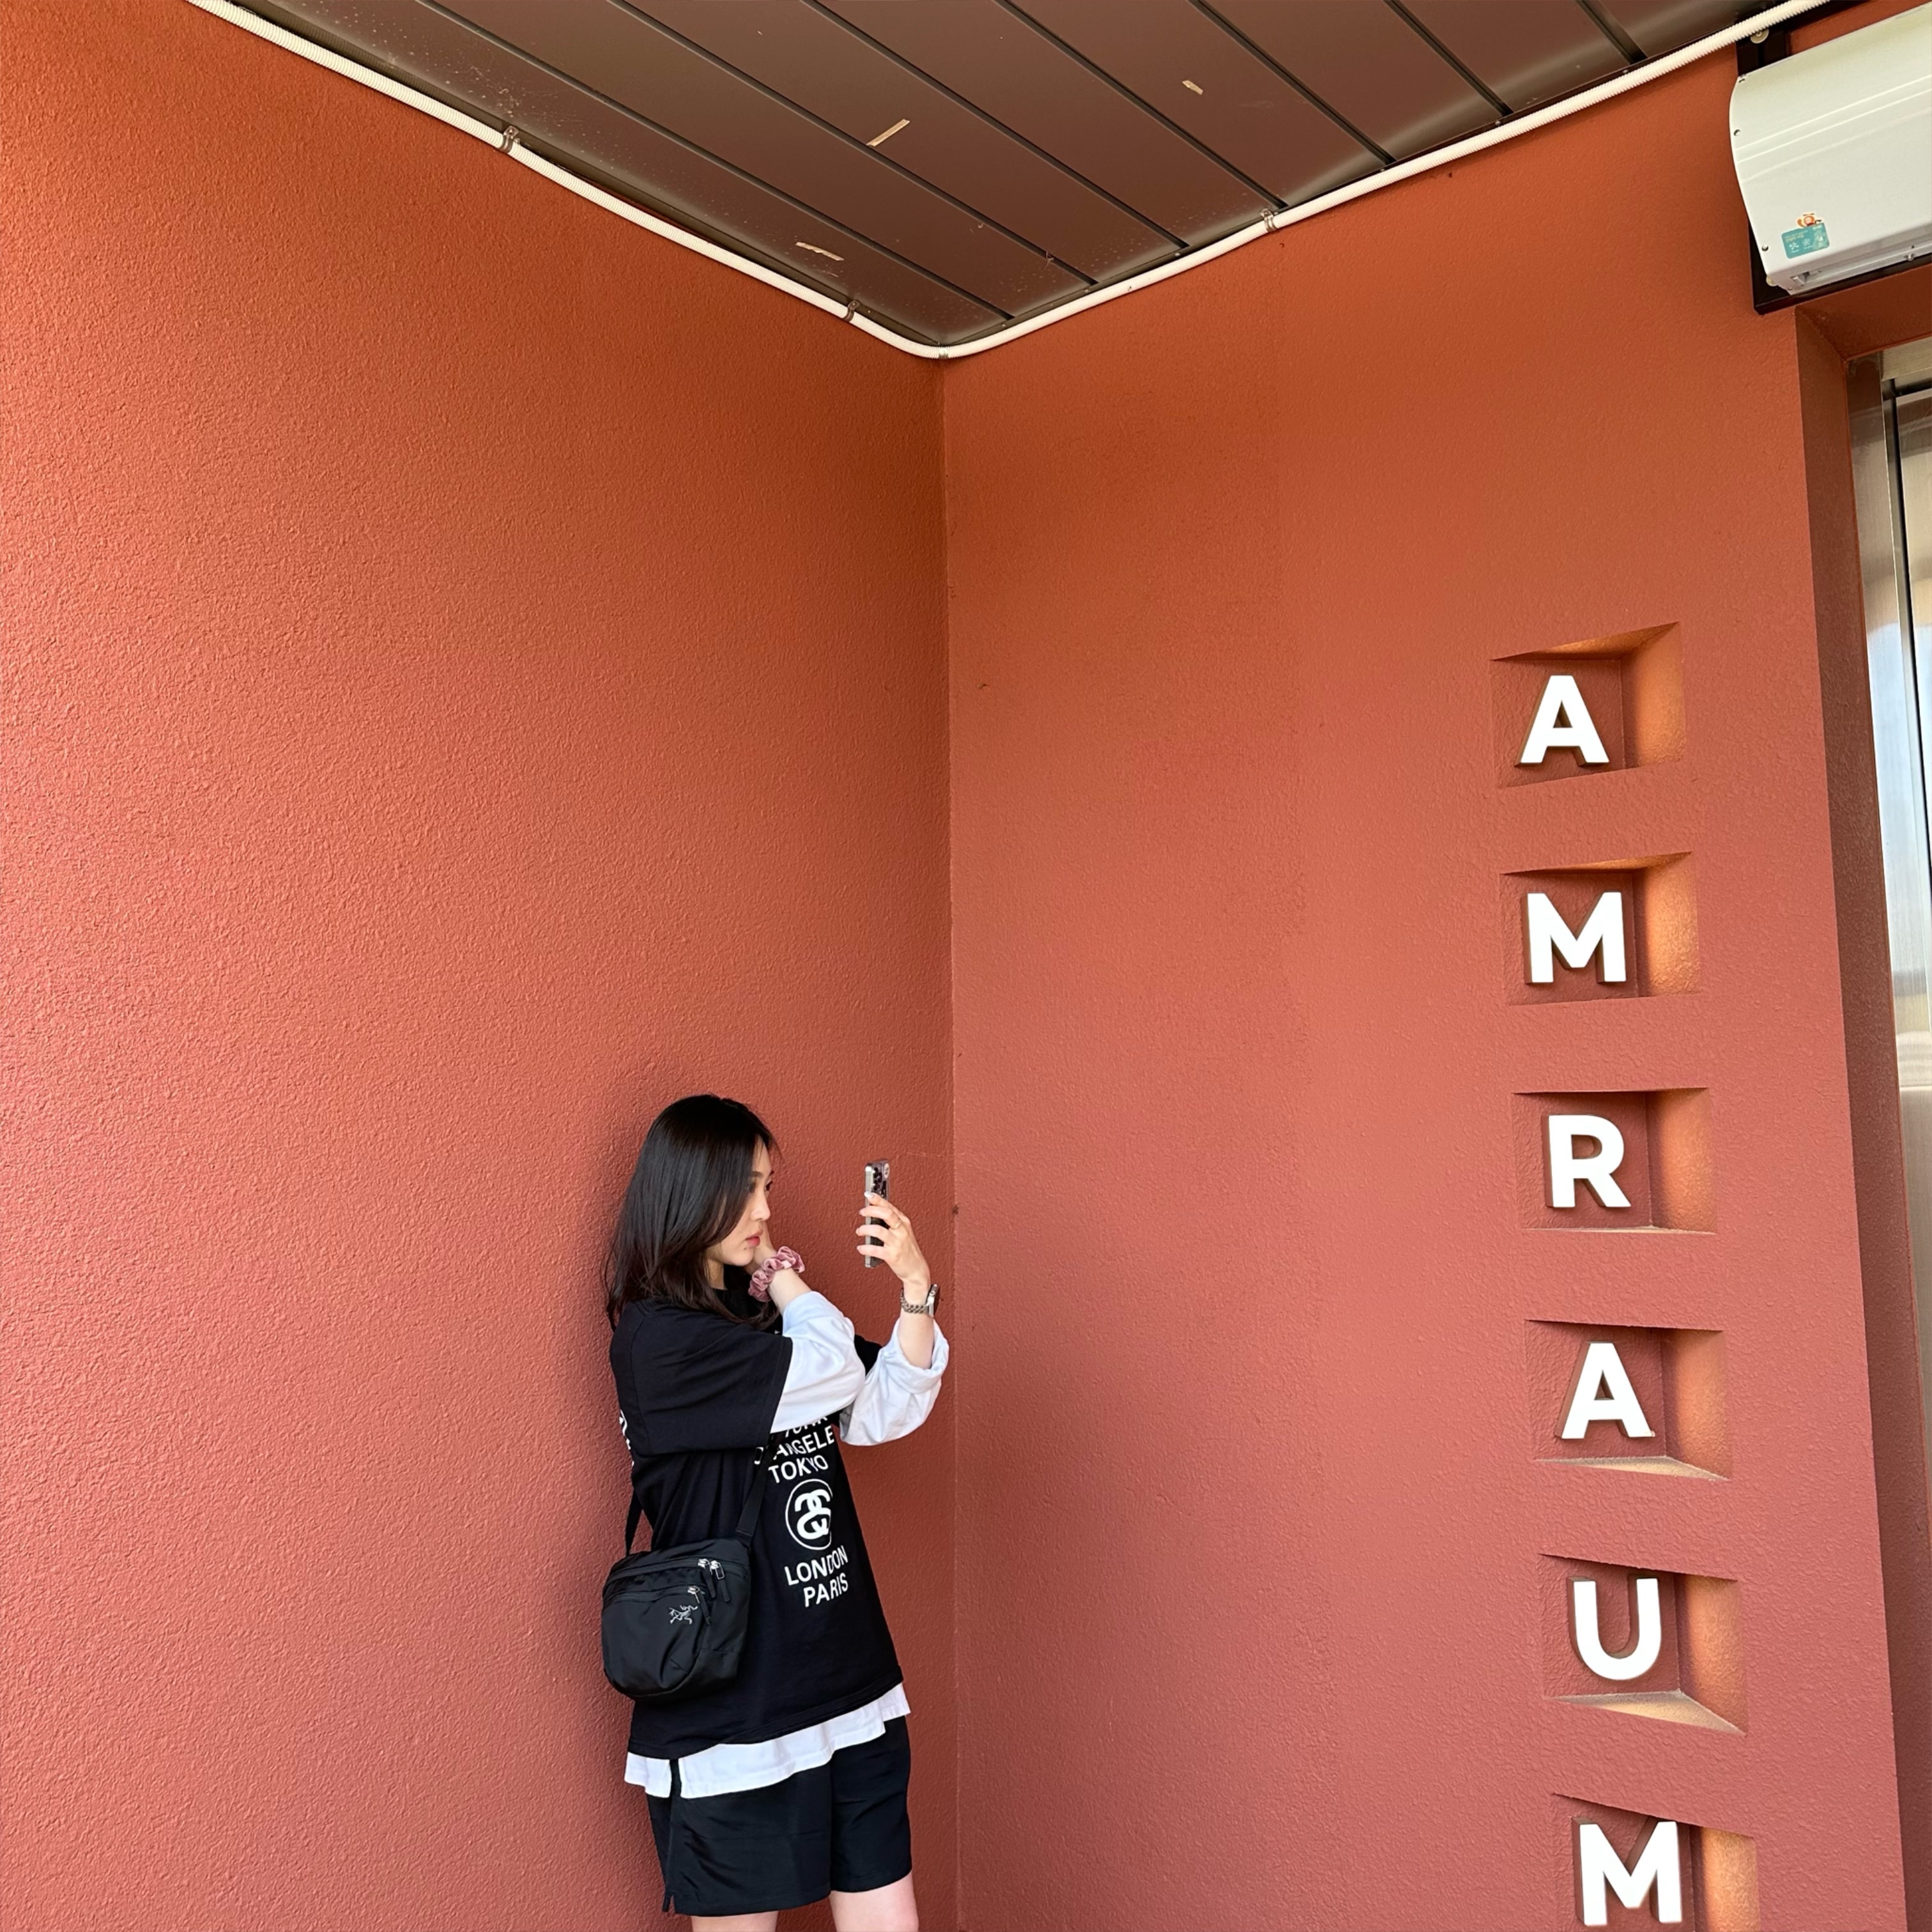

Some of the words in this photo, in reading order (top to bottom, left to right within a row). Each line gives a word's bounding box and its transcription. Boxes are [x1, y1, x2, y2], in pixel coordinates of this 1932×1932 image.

[1519, 675, 1682, 1926] AMRAUM
[772, 1425, 834, 1460] ANGELE
[768, 1455, 829, 1483] TOKYO
[784, 1545, 848, 1586] LONDON
[803, 1572, 848, 1607] PARIS
